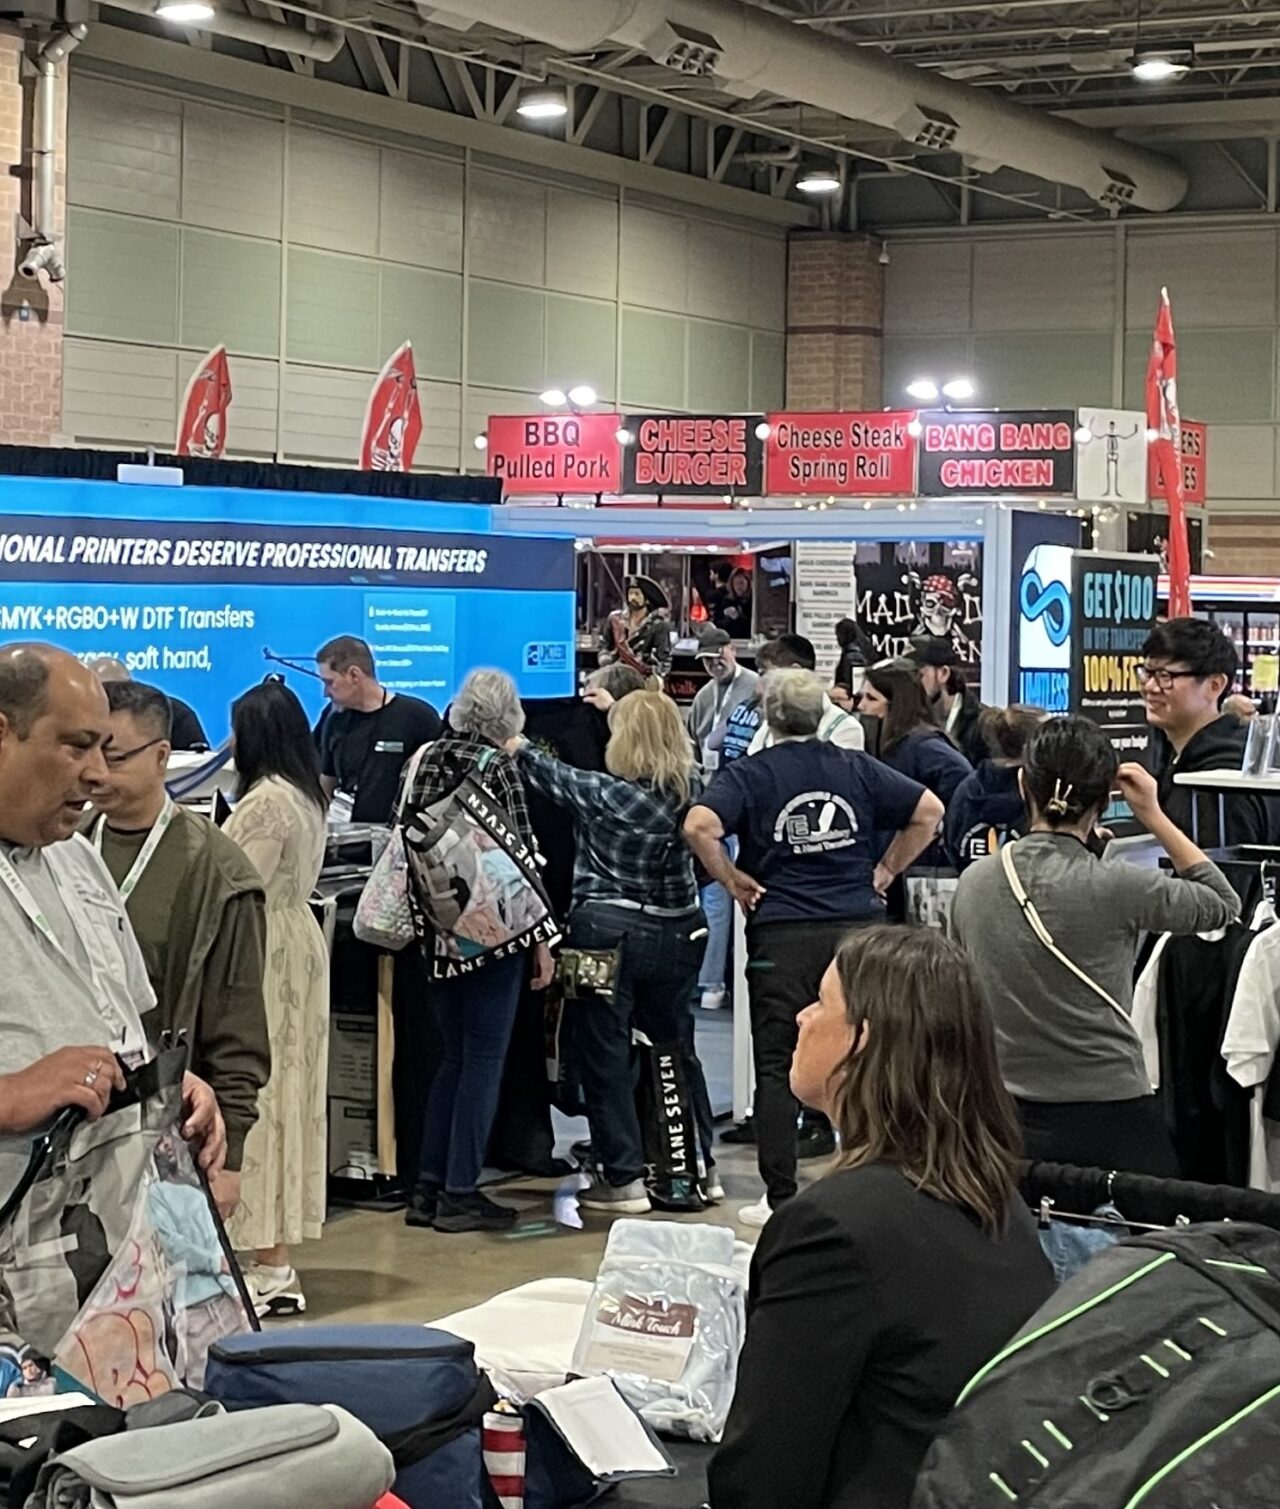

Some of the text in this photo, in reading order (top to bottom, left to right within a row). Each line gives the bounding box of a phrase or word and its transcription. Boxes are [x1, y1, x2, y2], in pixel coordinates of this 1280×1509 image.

[525, 421, 580, 448] BBQ
[639, 419, 747, 452] CHEESE
[776, 420, 904, 449] Cheese Steak
[925, 422, 1071, 451] BANG BANG
[493, 453, 610, 479] Pulled Pork
[635, 452, 748, 485] BURGER
[789, 453, 890, 485] Spring Roll
[940, 459, 1054, 487] CHICKEN
[68, 536, 170, 566] PRINTERS
[172, 540, 260, 568] DESERVE
[260, 541, 392, 571] PROFESSIONAL
[396, 546, 487, 573] TRANSFERS
[1083, 570, 1153, 625] GET $100
[142, 606, 174, 630] DTF
[178, 604, 255, 629] Transfers
[125, 645, 160, 671] soft
[162, 644, 212, 672] hand,
[1083, 654, 1122, 692] 100%
[467, 793, 516, 847] SEVEN
[433, 917, 558, 979] LANE SEVEN
[659, 1055, 687, 1173] LANE SEVEN
[647, 1317, 682, 1335] Touch
